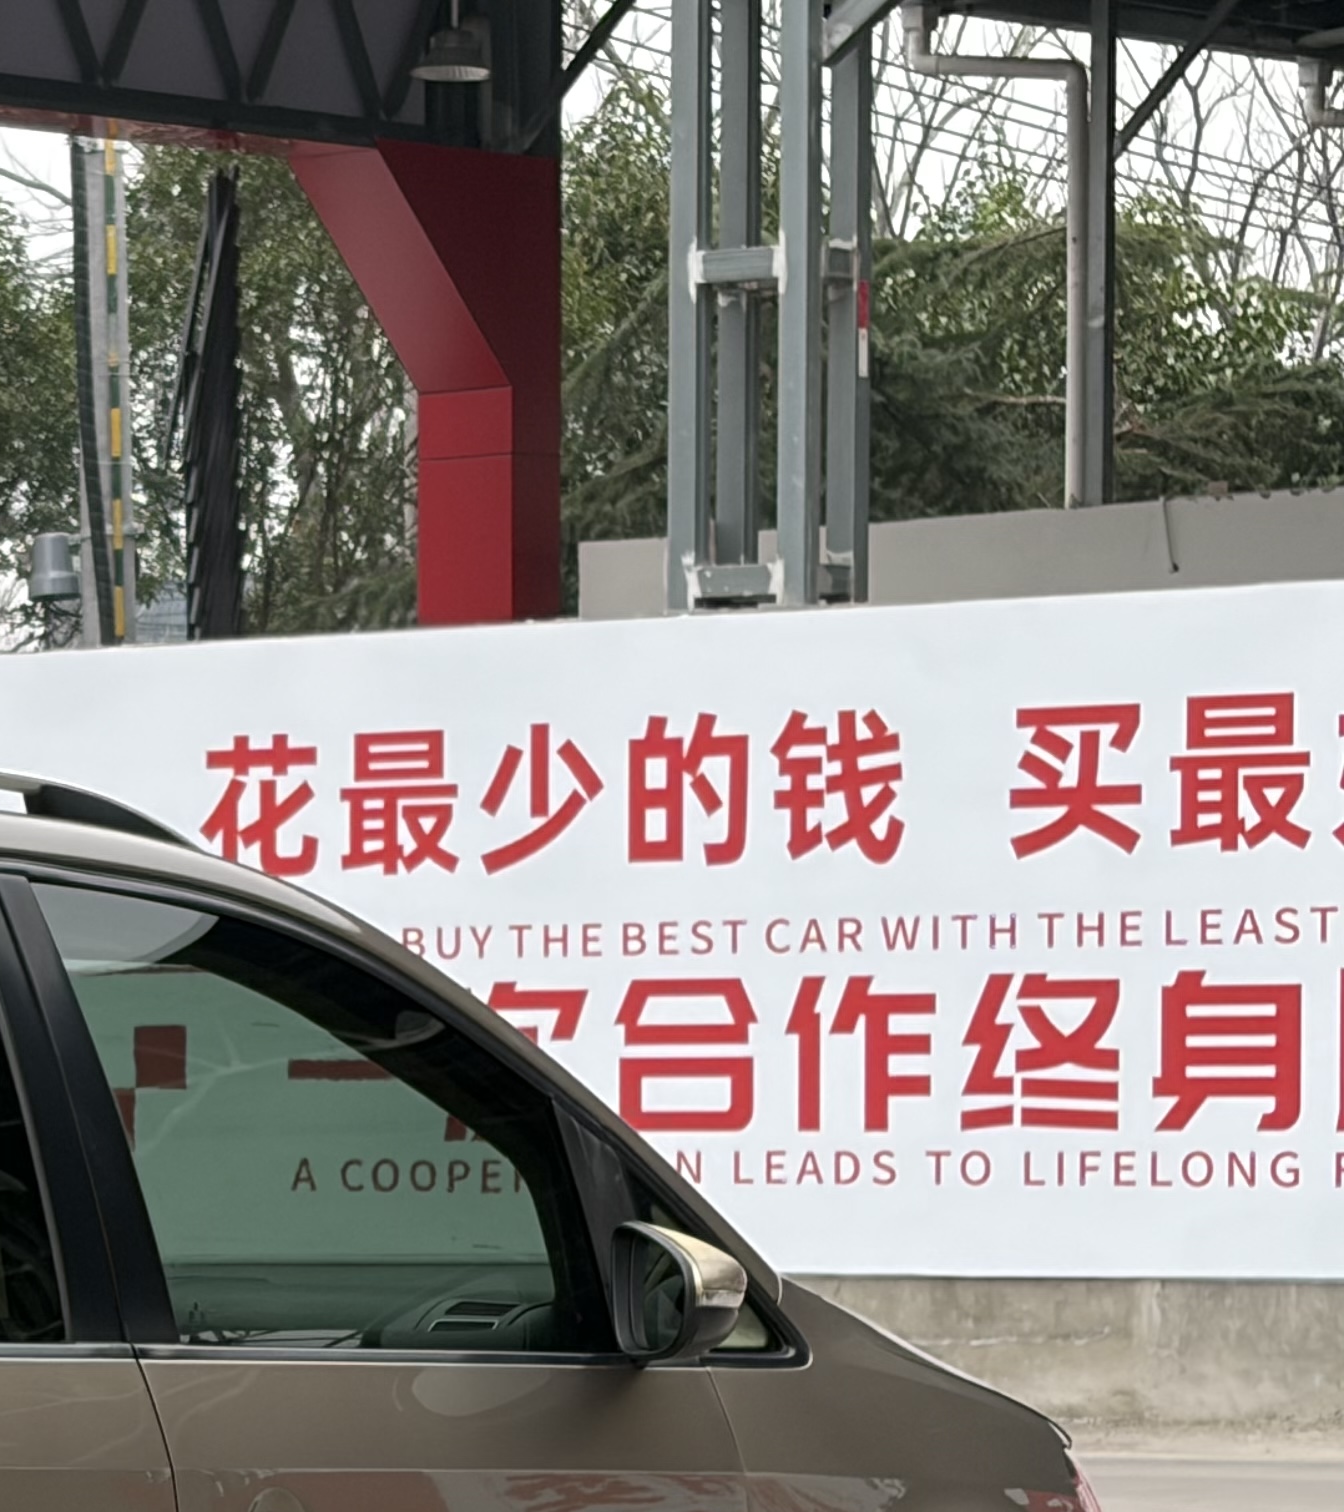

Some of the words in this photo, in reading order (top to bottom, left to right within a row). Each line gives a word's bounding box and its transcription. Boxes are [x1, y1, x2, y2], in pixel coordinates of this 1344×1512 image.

[200, 711, 904, 877] 花最少的钱
[1009, 692, 1344, 858] 买最
[402, 925, 492, 960] BUY
[510, 924, 603, 958] THE
[622, 920, 747, 957] BEST
[765, 918, 864, 954] CAR
[881, 914, 1018, 951] WITH
[1038, 911, 1143, 947] THE
[1164, 906, 1339, 946] LEAST
[291, 1157, 316, 1191] A
[733, 1150, 898, 1187] LEADS
[925, 1150, 993, 1186] TO
[1023, 1150, 1302, 1189] LIFELONG
